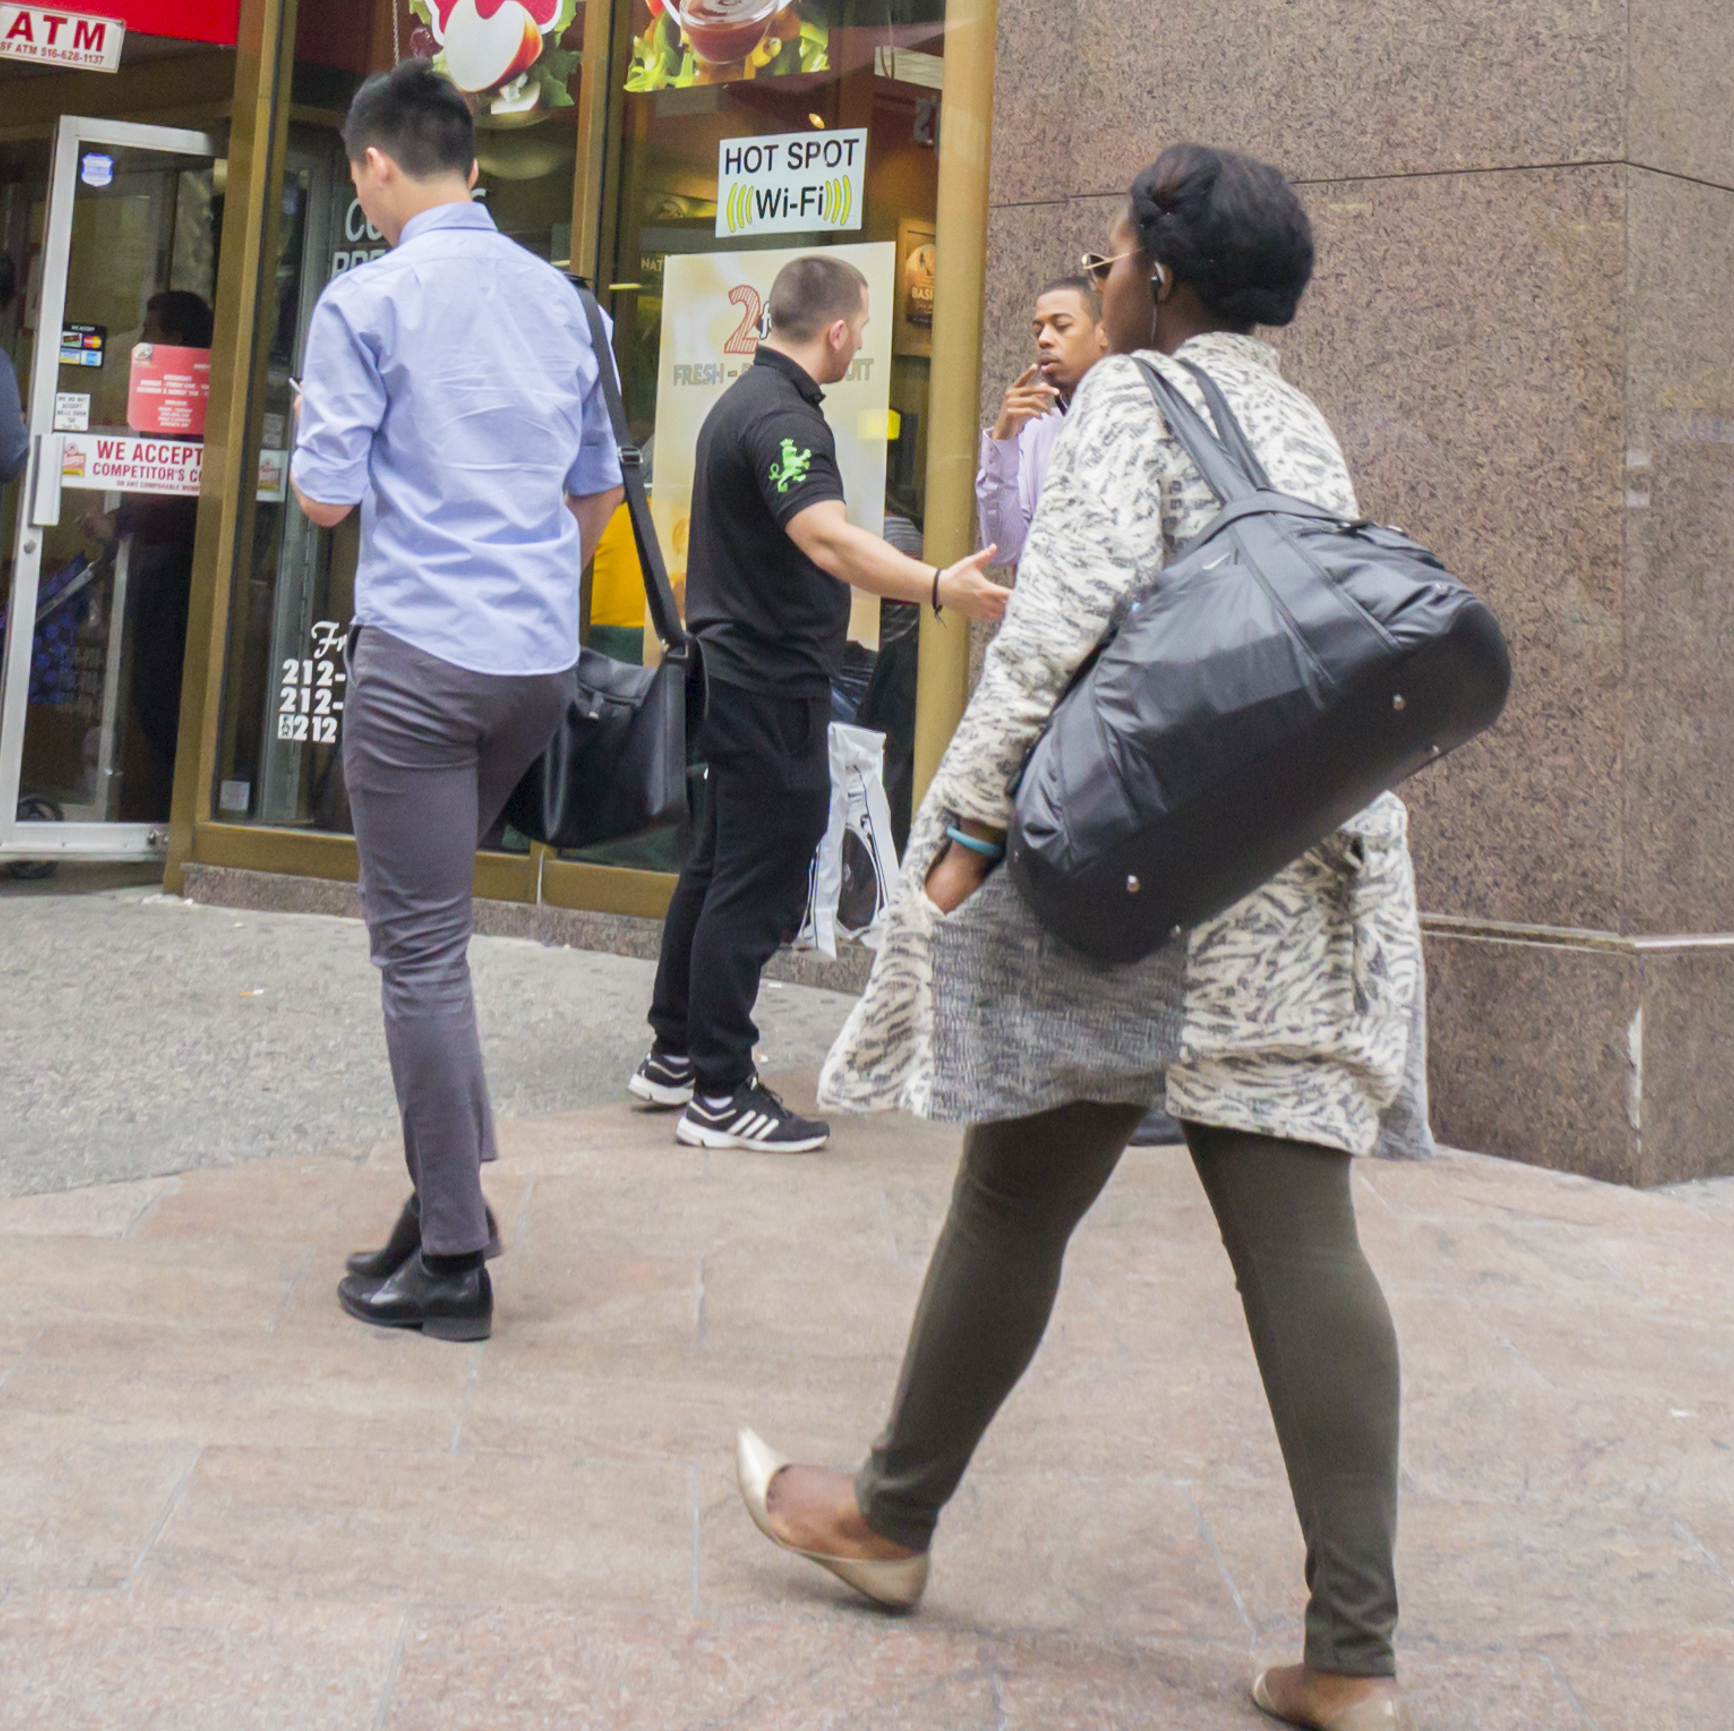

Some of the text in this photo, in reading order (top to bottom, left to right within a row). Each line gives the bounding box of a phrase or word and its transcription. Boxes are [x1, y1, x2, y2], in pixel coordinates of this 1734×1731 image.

[5, 11, 106, 52] ATM
[0, 41, 13, 51] SF
[15, 43, 37, 55] ATM
[725, 138, 859, 176] HOT SPOT
[755, 185, 824, 220] Wi-Fi
[97, 440, 203, 466] WE ACCEPT
[92, 462, 186, 482] COMPETITOR'S
